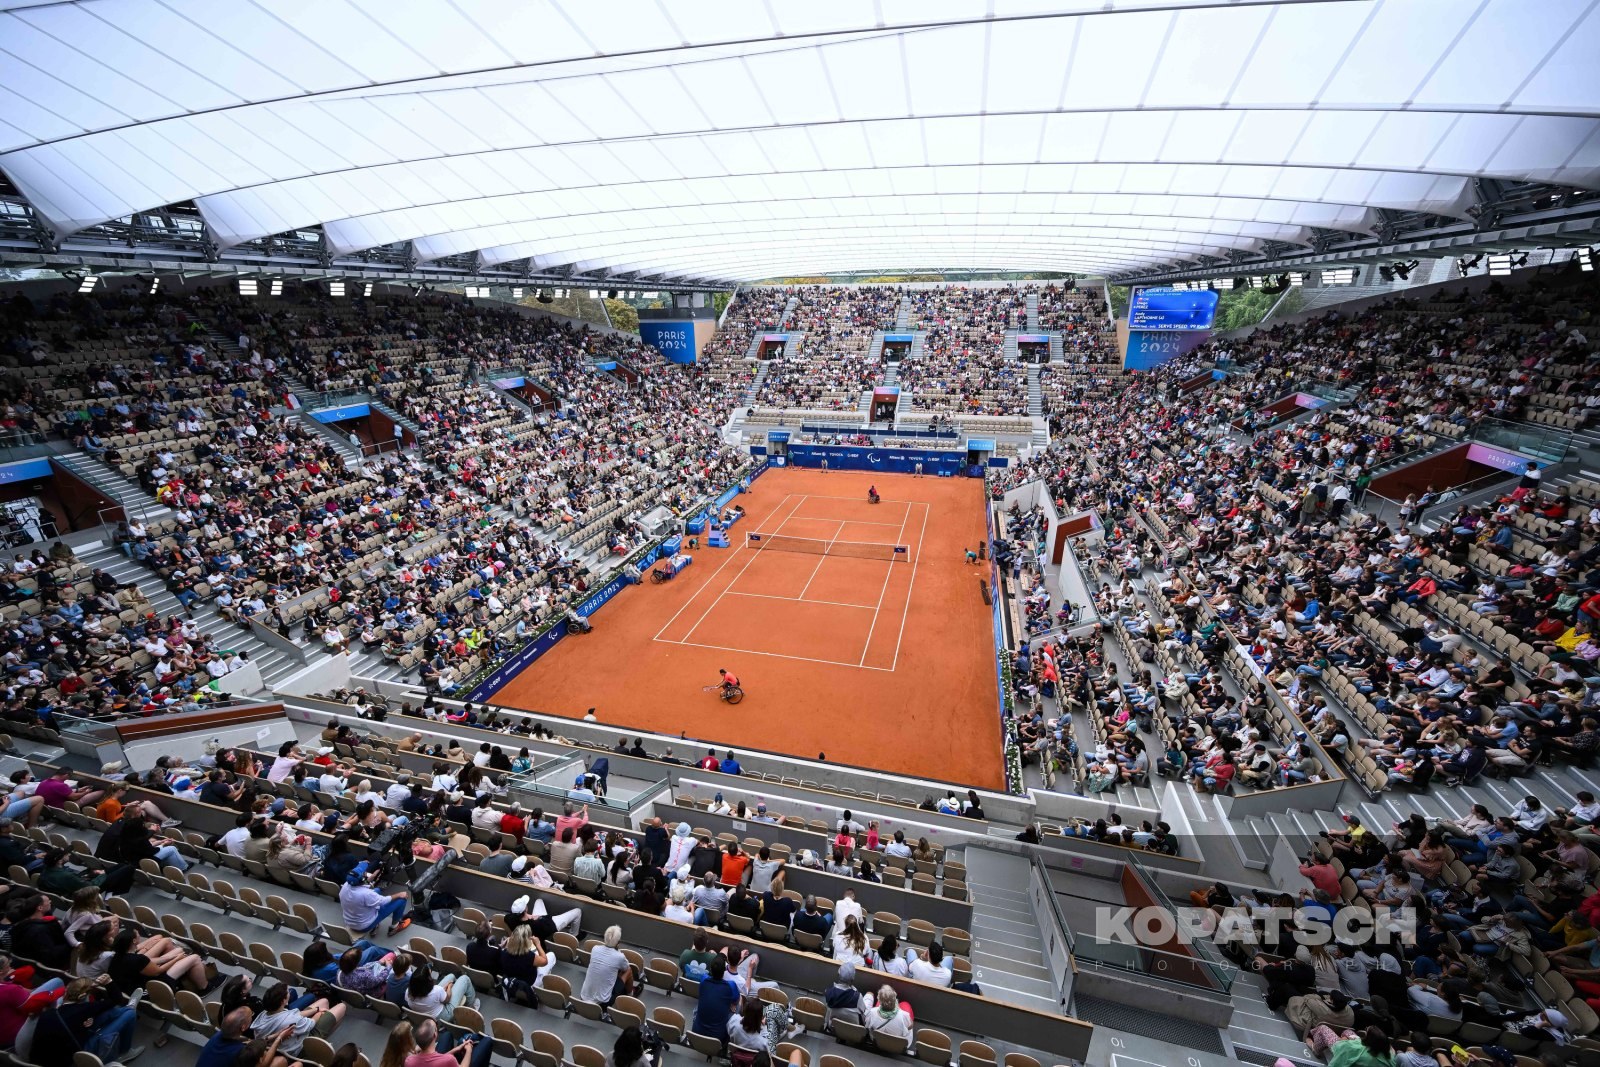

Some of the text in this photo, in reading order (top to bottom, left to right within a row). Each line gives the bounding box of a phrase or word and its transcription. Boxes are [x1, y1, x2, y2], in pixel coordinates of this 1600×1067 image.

[657, 331, 686, 340] PARIS
[1142, 332, 1182, 341] PARIS
[658, 340, 687, 349] 2024
[1140, 342, 1180, 353] 2024
[1487, 454, 1506, 464] PARIS
[584, 582, 620, 613] PARIS 2024
